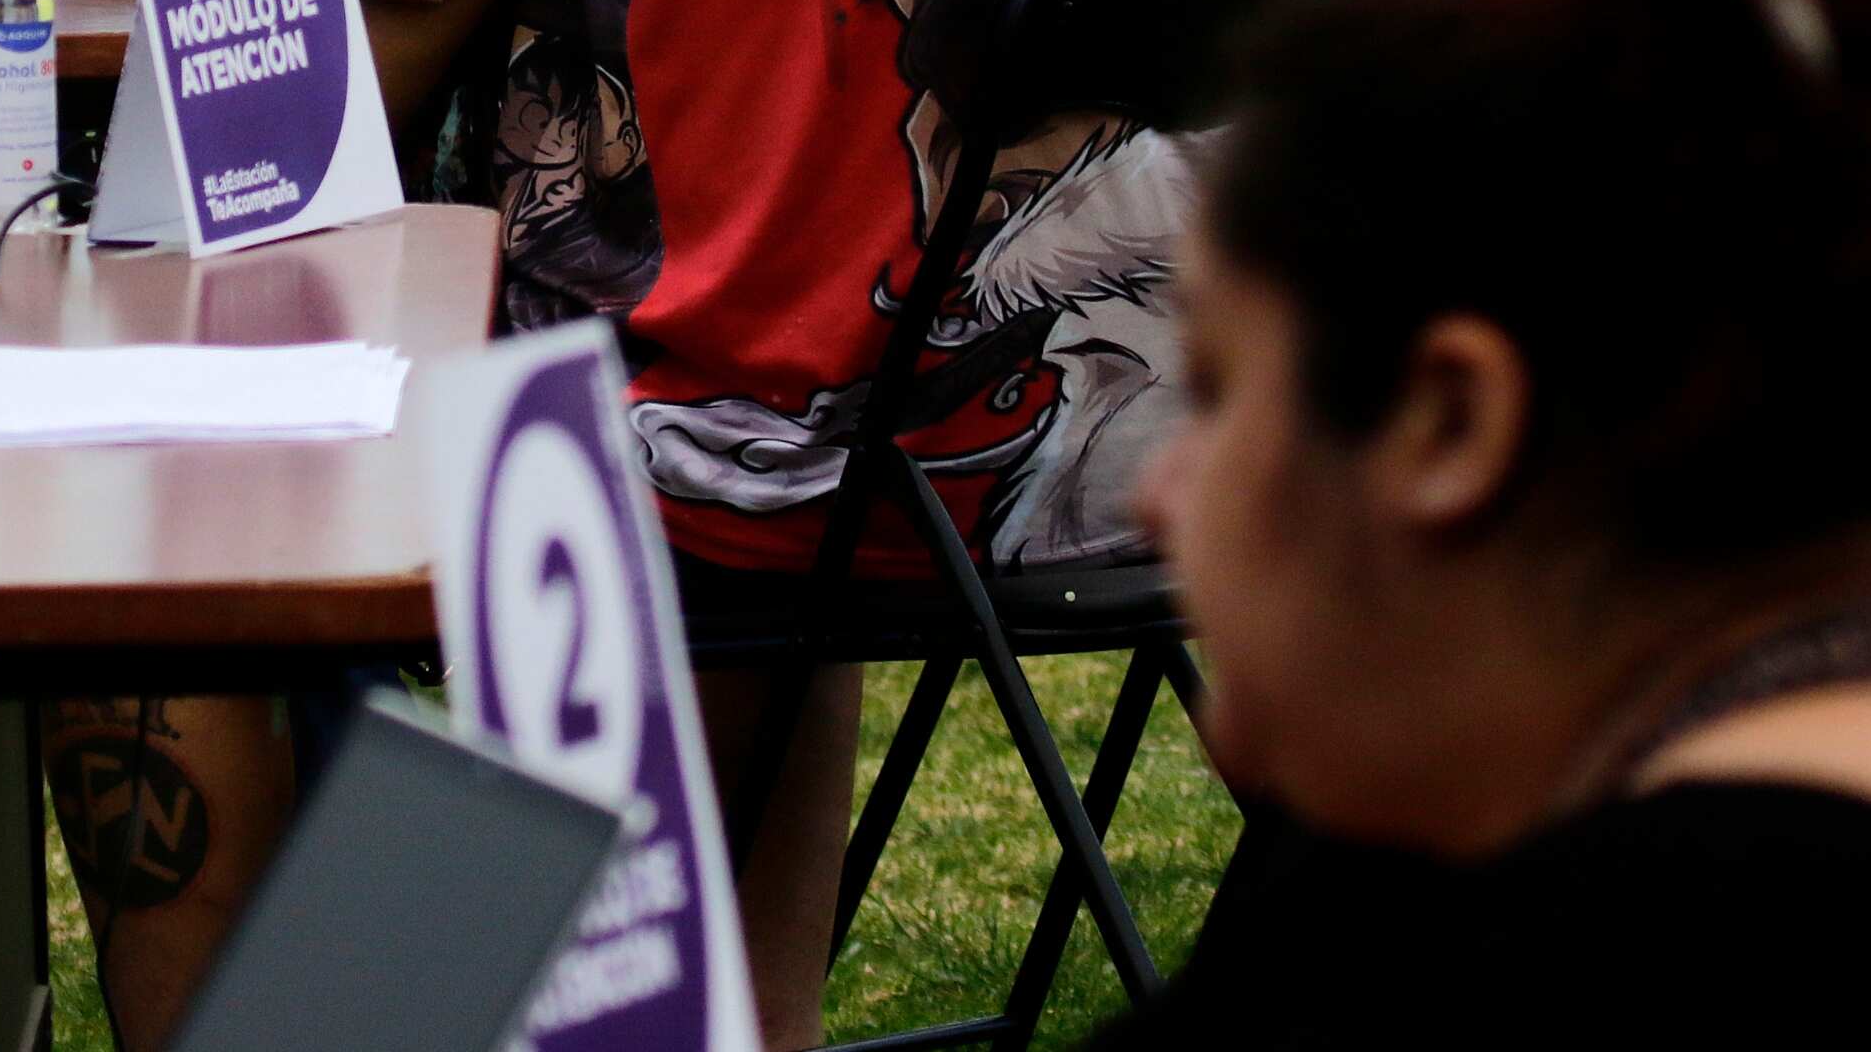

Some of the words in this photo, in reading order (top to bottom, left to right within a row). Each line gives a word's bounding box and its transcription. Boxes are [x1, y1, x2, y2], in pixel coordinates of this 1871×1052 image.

[180, 26, 310, 98] ATENCIÓN
[202, 160, 279, 198] #LaEstación
[205, 178, 301, 223] TeAcompaña
[534, 537, 599, 746] 2
